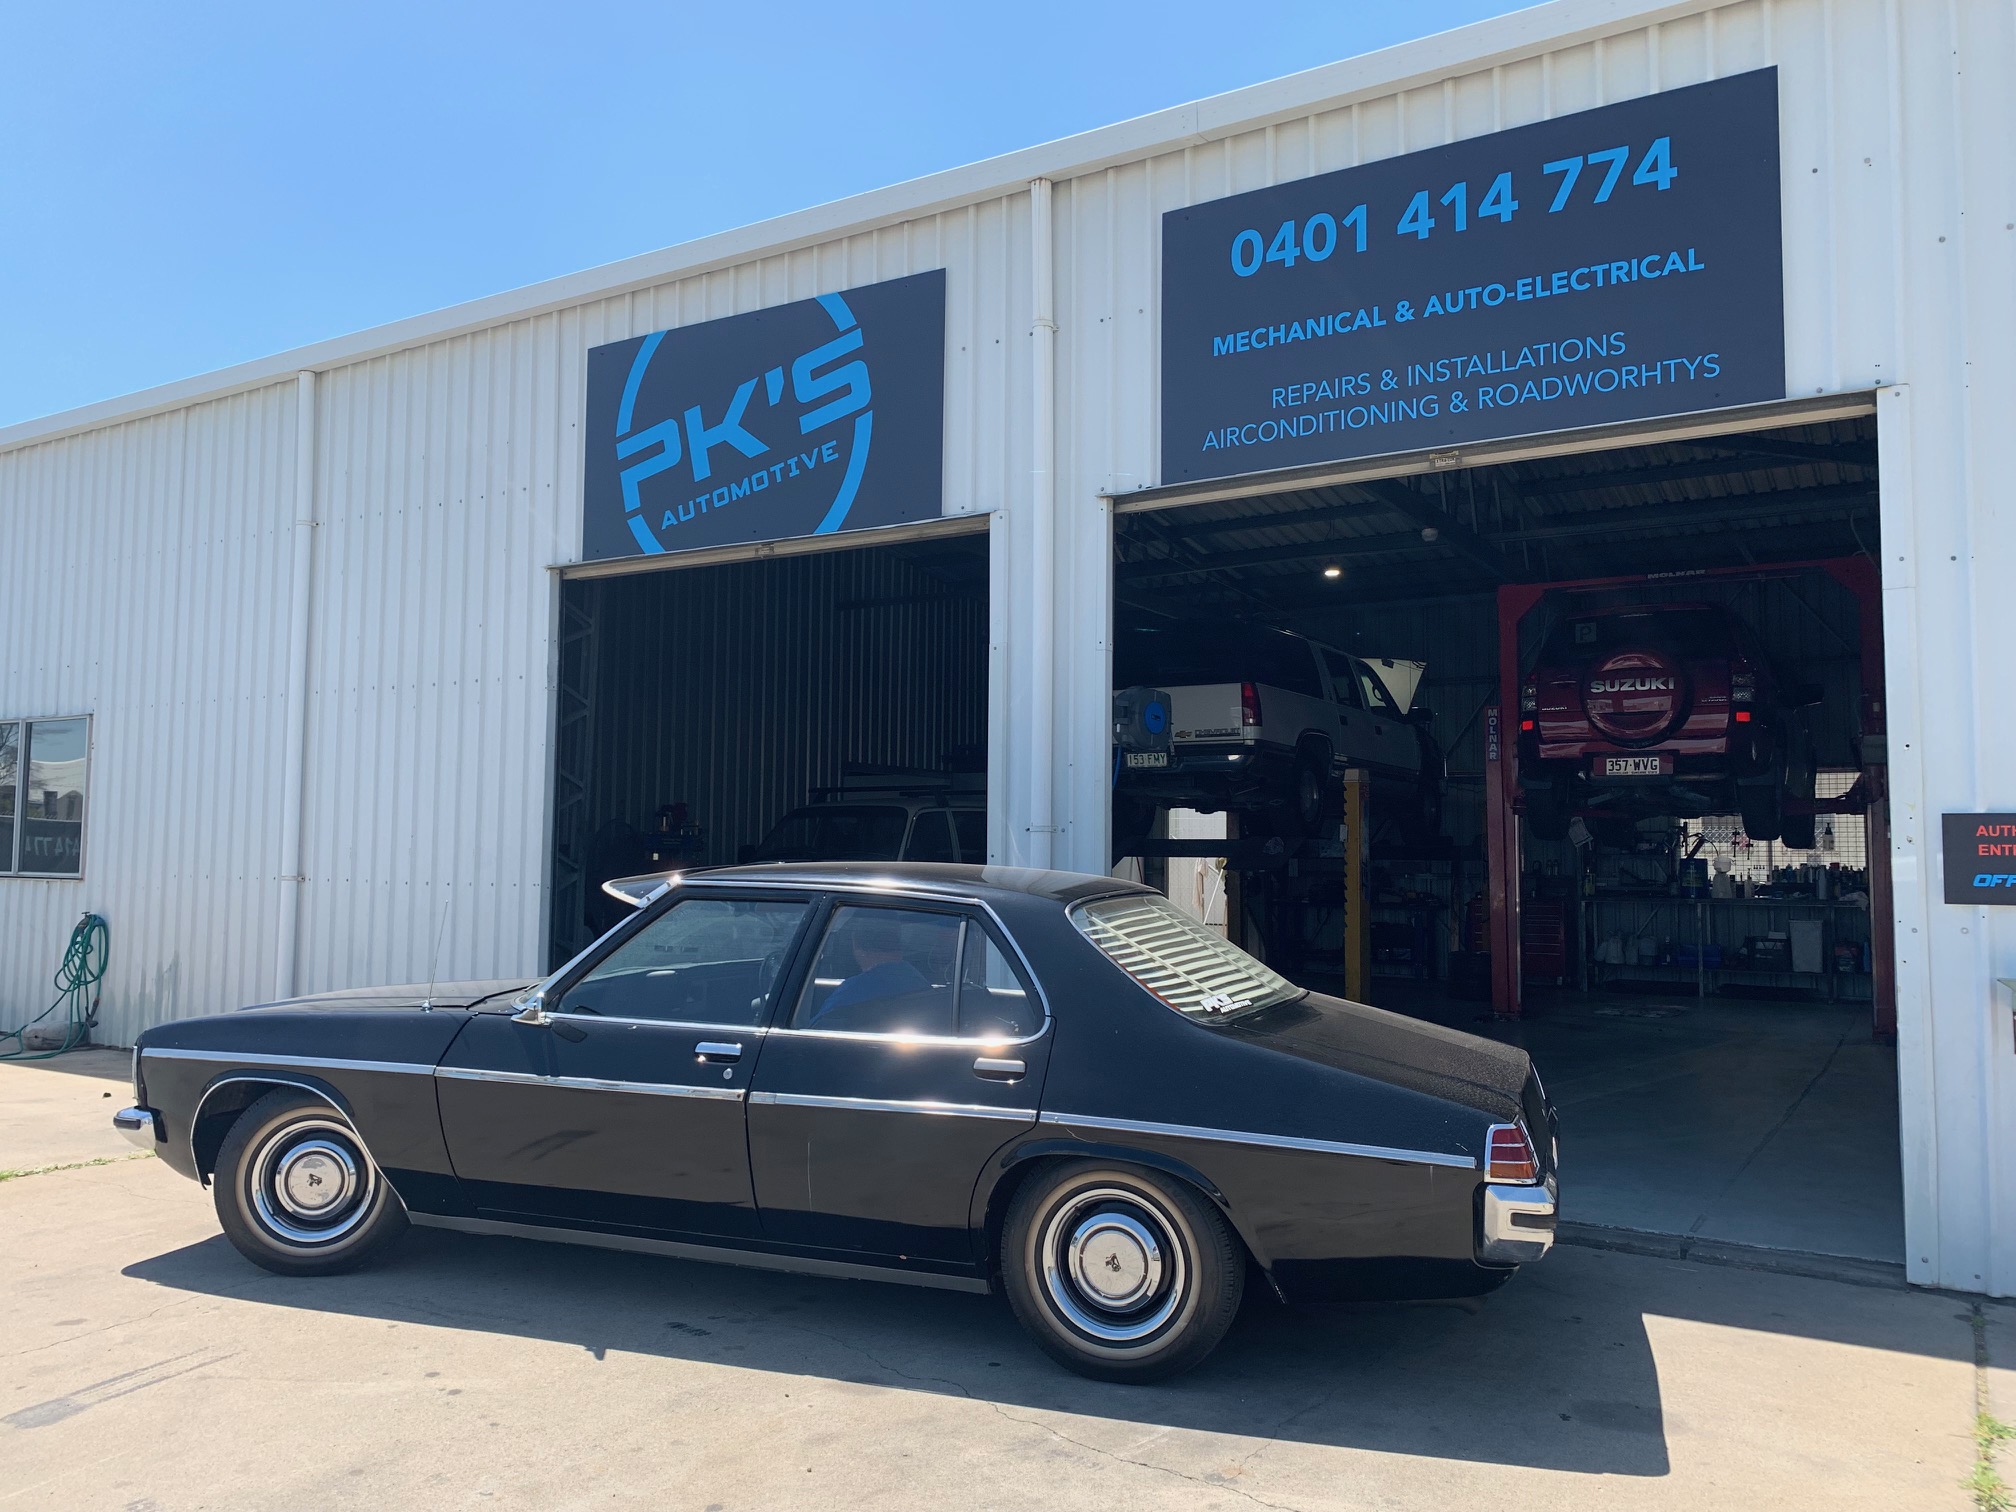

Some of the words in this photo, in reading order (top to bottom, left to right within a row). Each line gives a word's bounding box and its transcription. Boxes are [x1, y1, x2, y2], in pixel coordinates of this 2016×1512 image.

[1230, 203, 1367, 278] 0401
[1396, 171, 1519, 240] 414
[1542, 136, 1678, 214] 774
[1212, 305, 1387, 357] MECHANICAL
[1394, 300, 1416, 323] &
[1422, 247, 1705, 318] AUTO-ELECTRICAL
[1202, 394, 1439, 451] AIRCONDITIONING
[1449, 390, 1469, 414] &
[1478, 353, 1721, 410] ROADWORHTYS
[1272, 372, 1371, 409] REPAIRS
[1379, 368, 1399, 391] &
[1407, 331, 1626, 387] INSTALLATIONS
[615, 327, 872, 514] PK'S
[661, 439, 839, 531] AUTOMOTIVE
[1590, 676, 1675, 693] SUZUKI
[1487, 708, 1499, 760] MOLNAR
